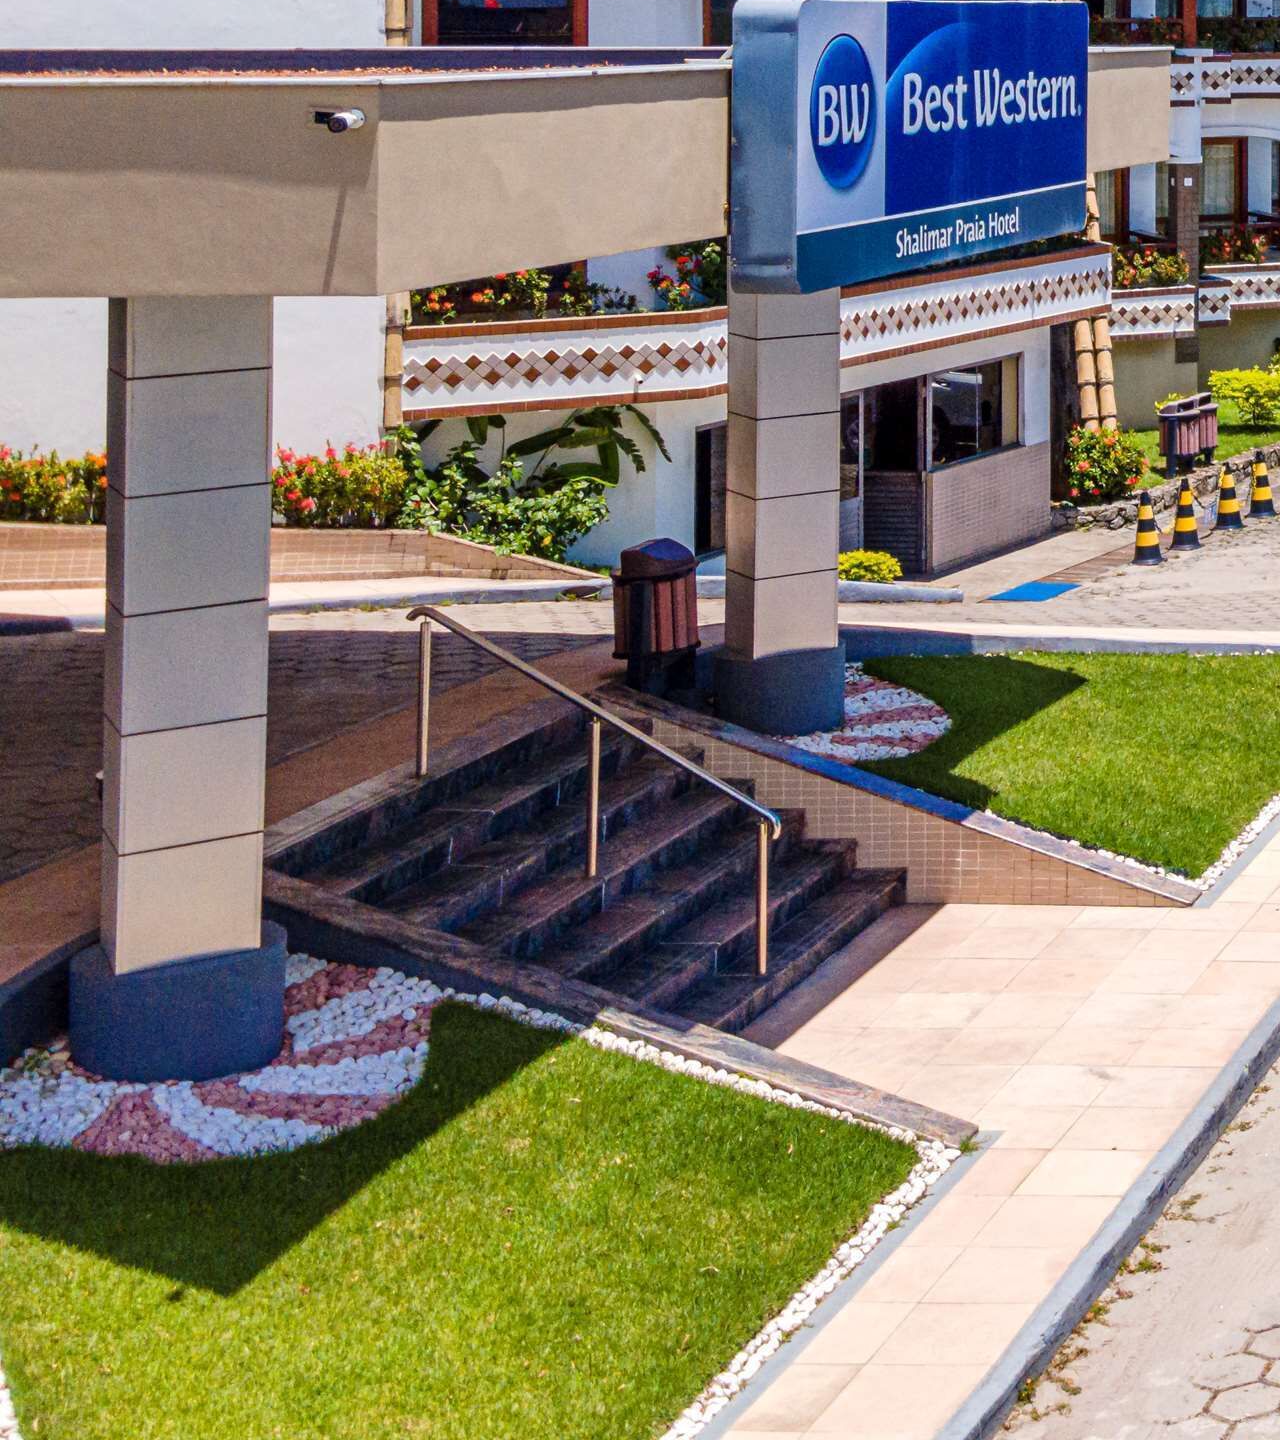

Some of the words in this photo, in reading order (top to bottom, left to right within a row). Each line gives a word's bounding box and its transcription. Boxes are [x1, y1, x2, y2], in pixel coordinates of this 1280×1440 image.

[817, 82, 871, 146] BW
[902, 72, 968, 135] Best
[973, 68, 1077, 127] Western
[895, 224, 953, 259] Shalimar
[955, 213, 986, 245] Praia
[988, 206, 1020, 238] Hotel
